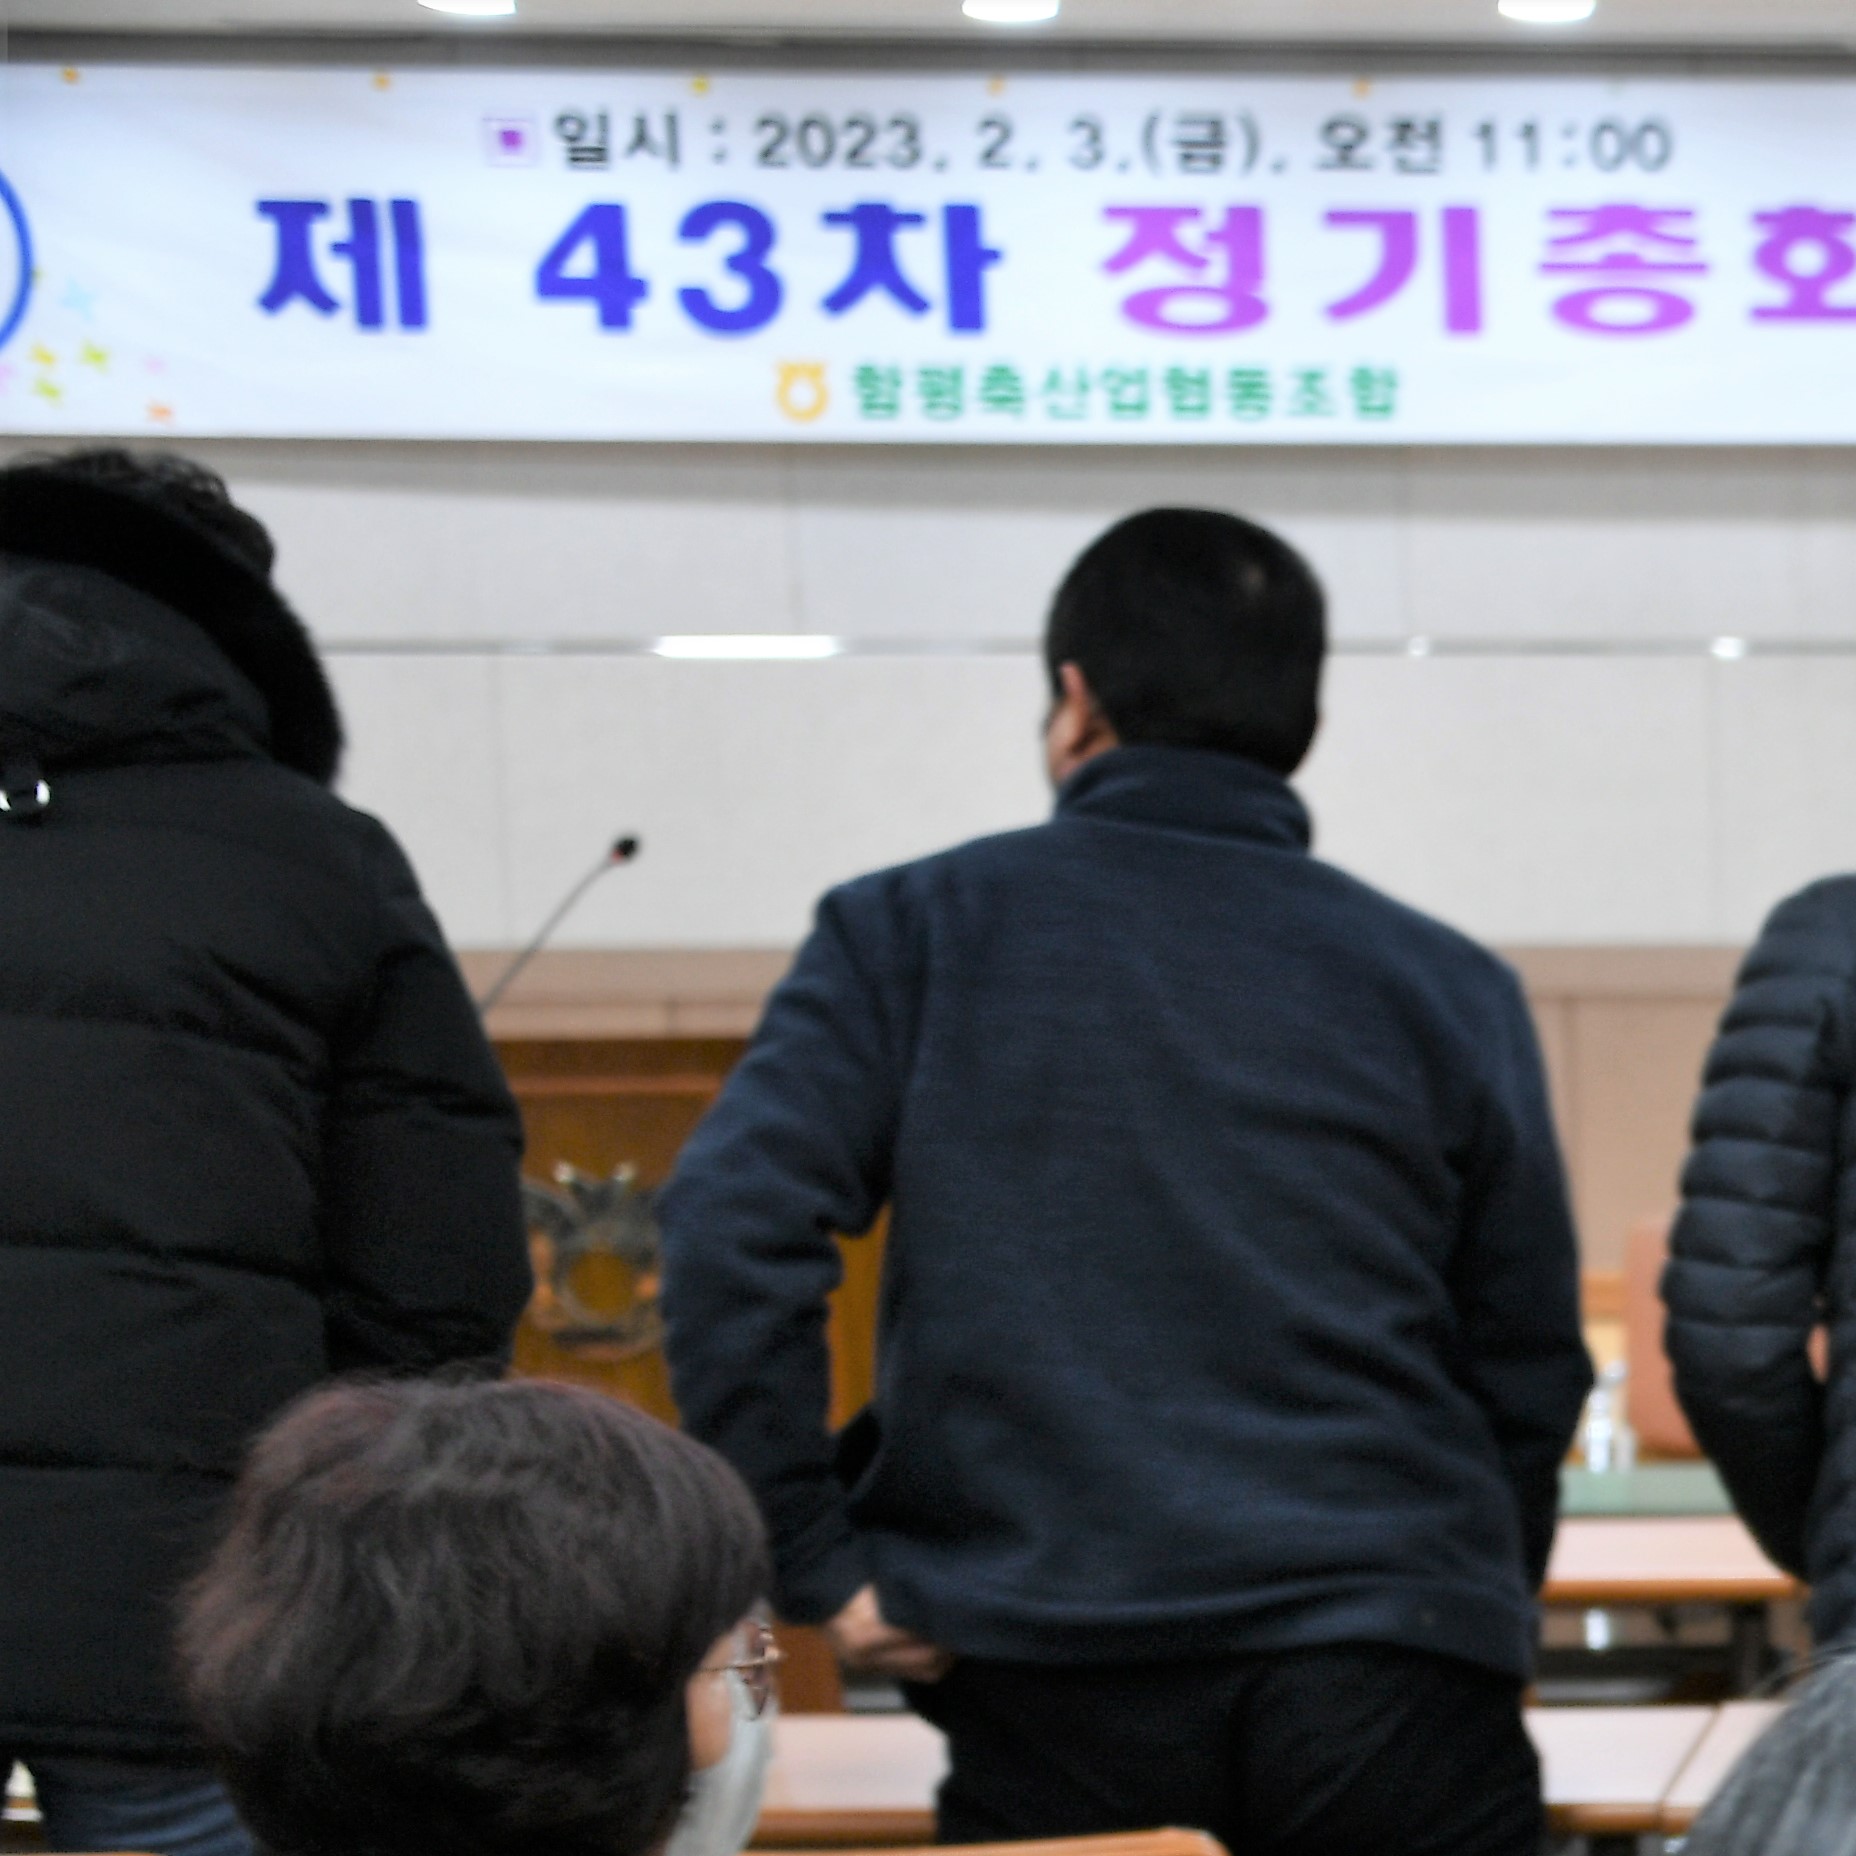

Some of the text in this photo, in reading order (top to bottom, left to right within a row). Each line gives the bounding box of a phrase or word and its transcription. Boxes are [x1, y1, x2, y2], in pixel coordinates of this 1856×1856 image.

[554, 110, 683, 168] 일시
[753, 115, 948, 172] 2023.
[977, 116, 1042, 171] 2.
[1314, 112, 1444, 173] 오전
[1470, 115, 1673, 172] 11:00
[257, 198, 428, 330] 제
[536, 200, 1003, 335] 43차
